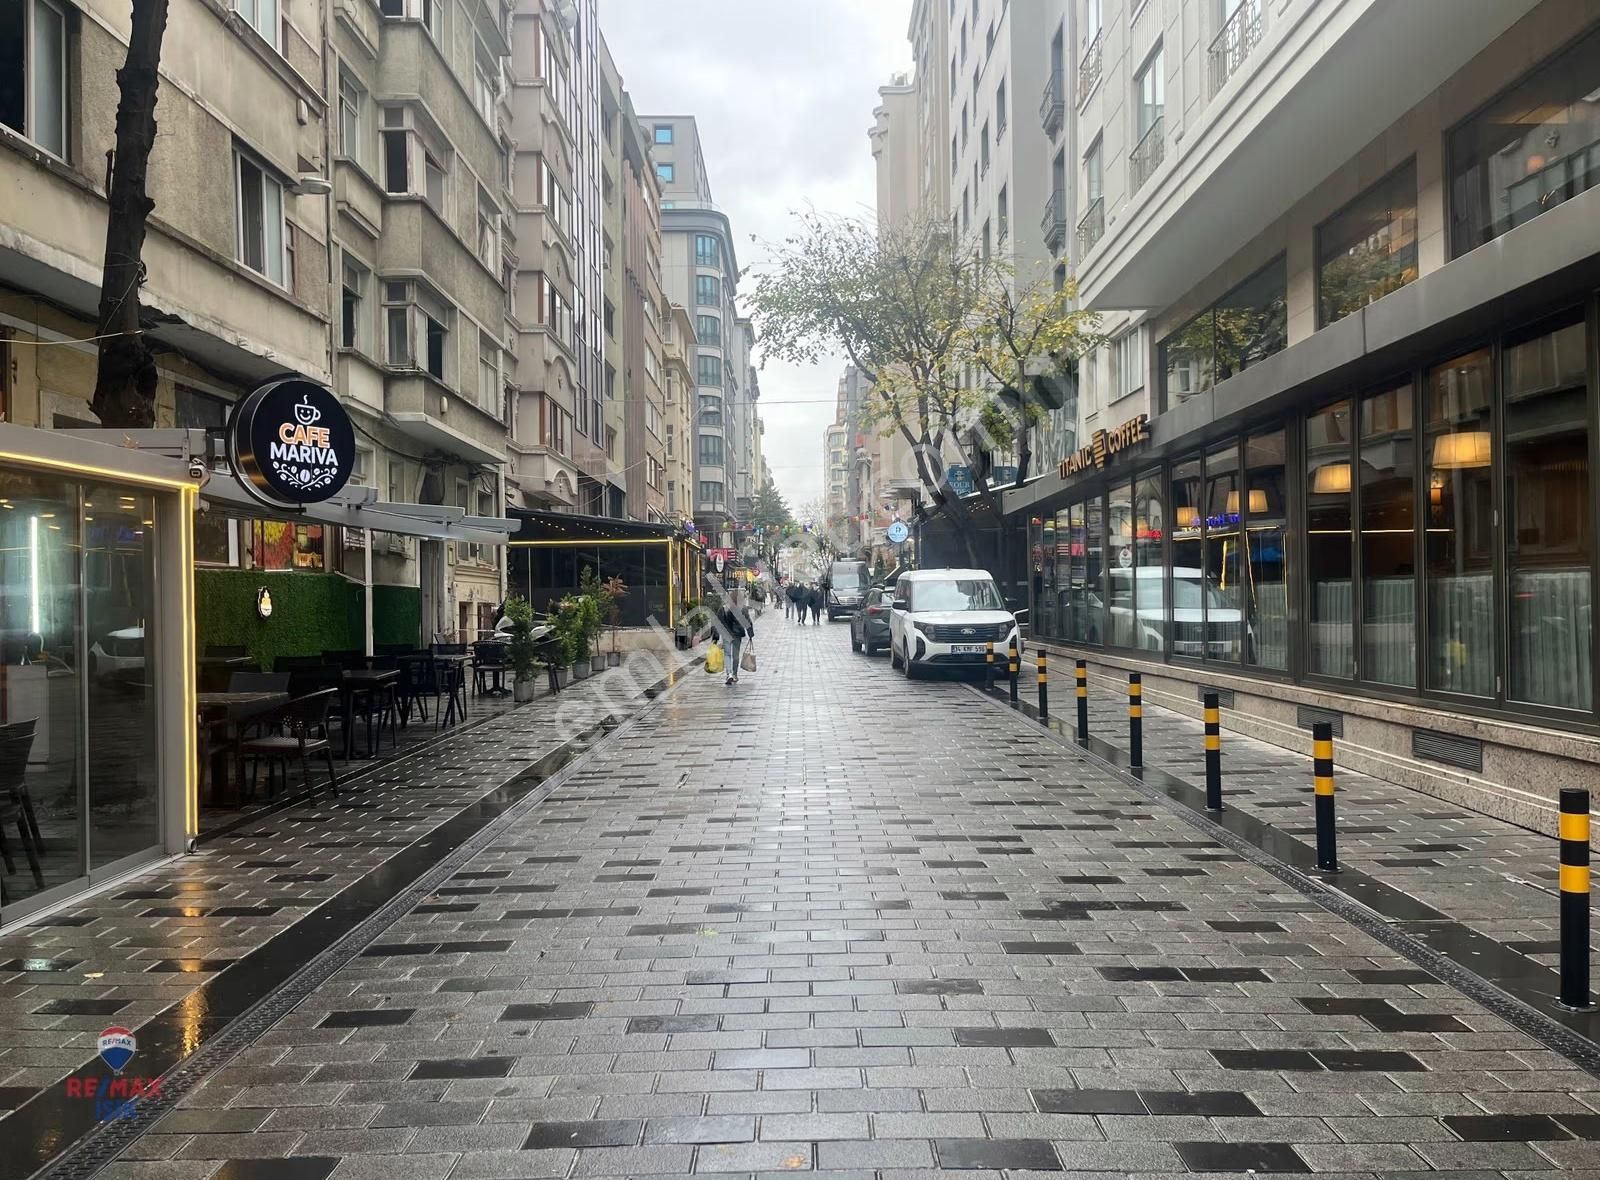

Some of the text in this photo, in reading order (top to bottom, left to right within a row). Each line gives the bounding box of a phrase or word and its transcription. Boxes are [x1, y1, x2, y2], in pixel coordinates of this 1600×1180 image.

[279, 422, 330, 449] CAFE
[1057, 413, 1149, 480] TITANIC COFFEE
[270, 441, 339, 466] MARIVA
